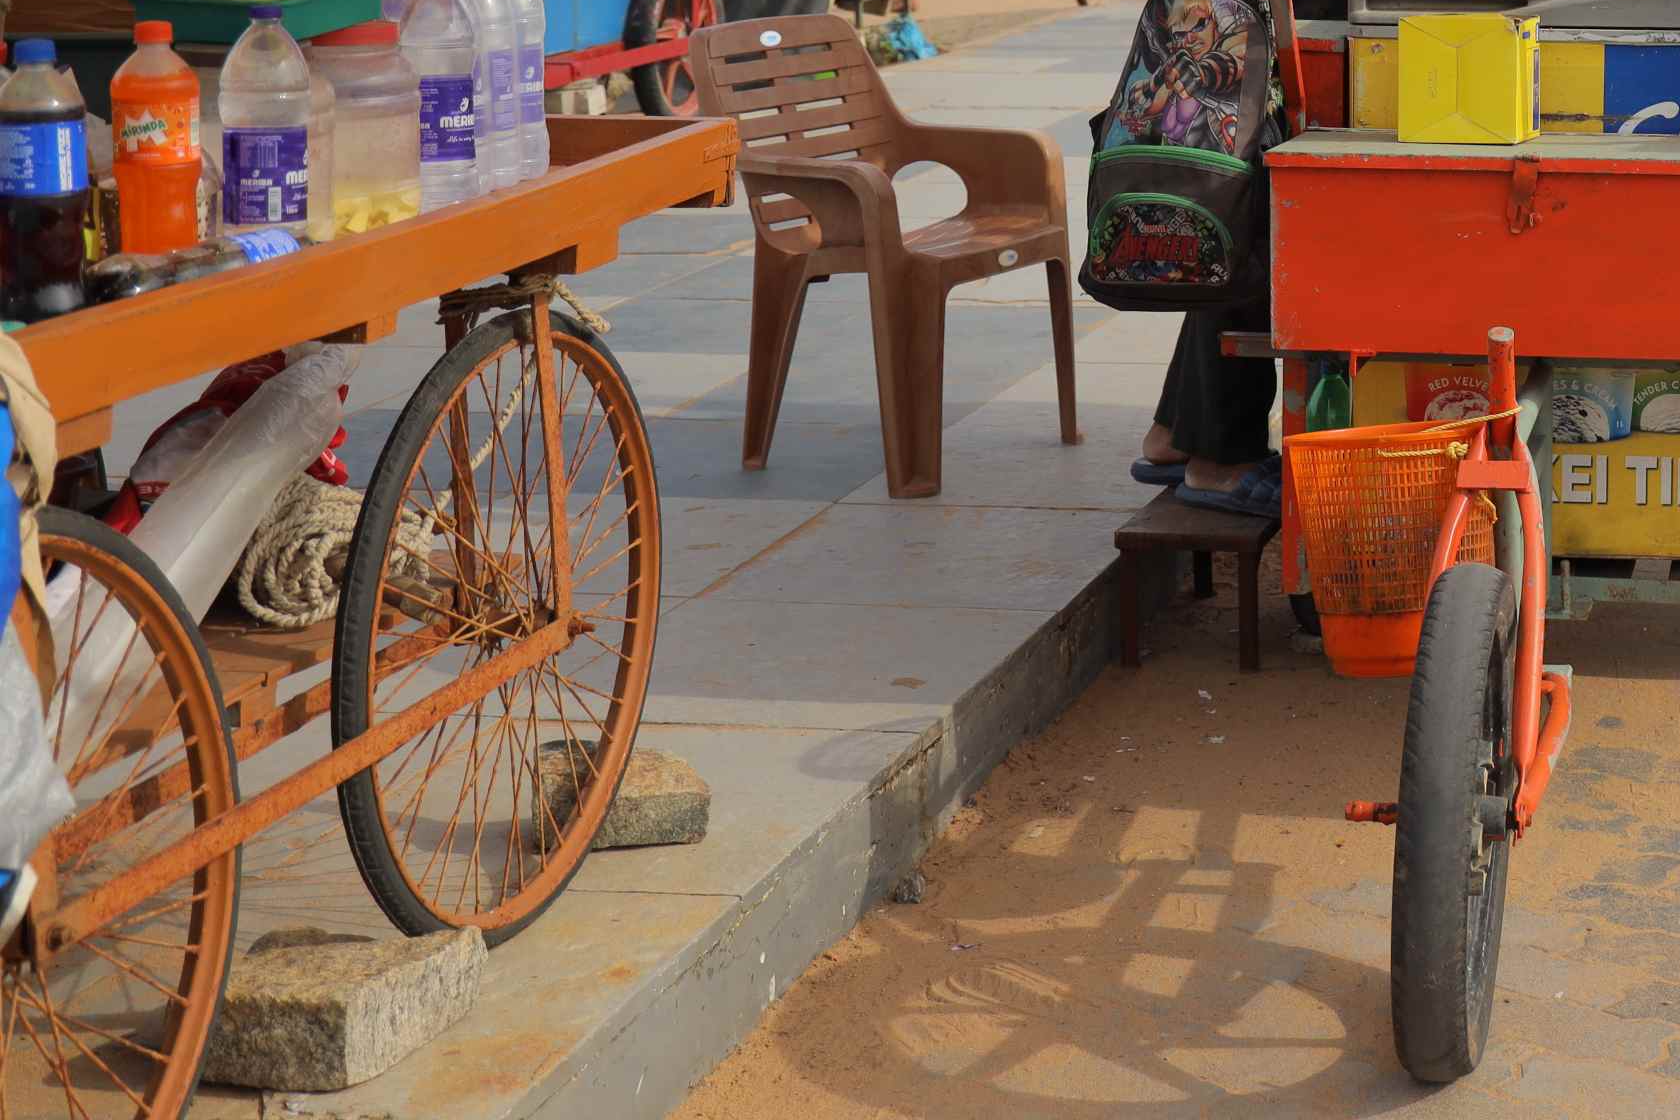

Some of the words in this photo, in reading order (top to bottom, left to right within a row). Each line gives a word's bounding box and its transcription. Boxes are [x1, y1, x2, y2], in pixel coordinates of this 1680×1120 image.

[1428, 378, 1449, 392] RED
[1454, 376, 1489, 392] VELVE
[1633, 381, 1667, 406] TENDER
